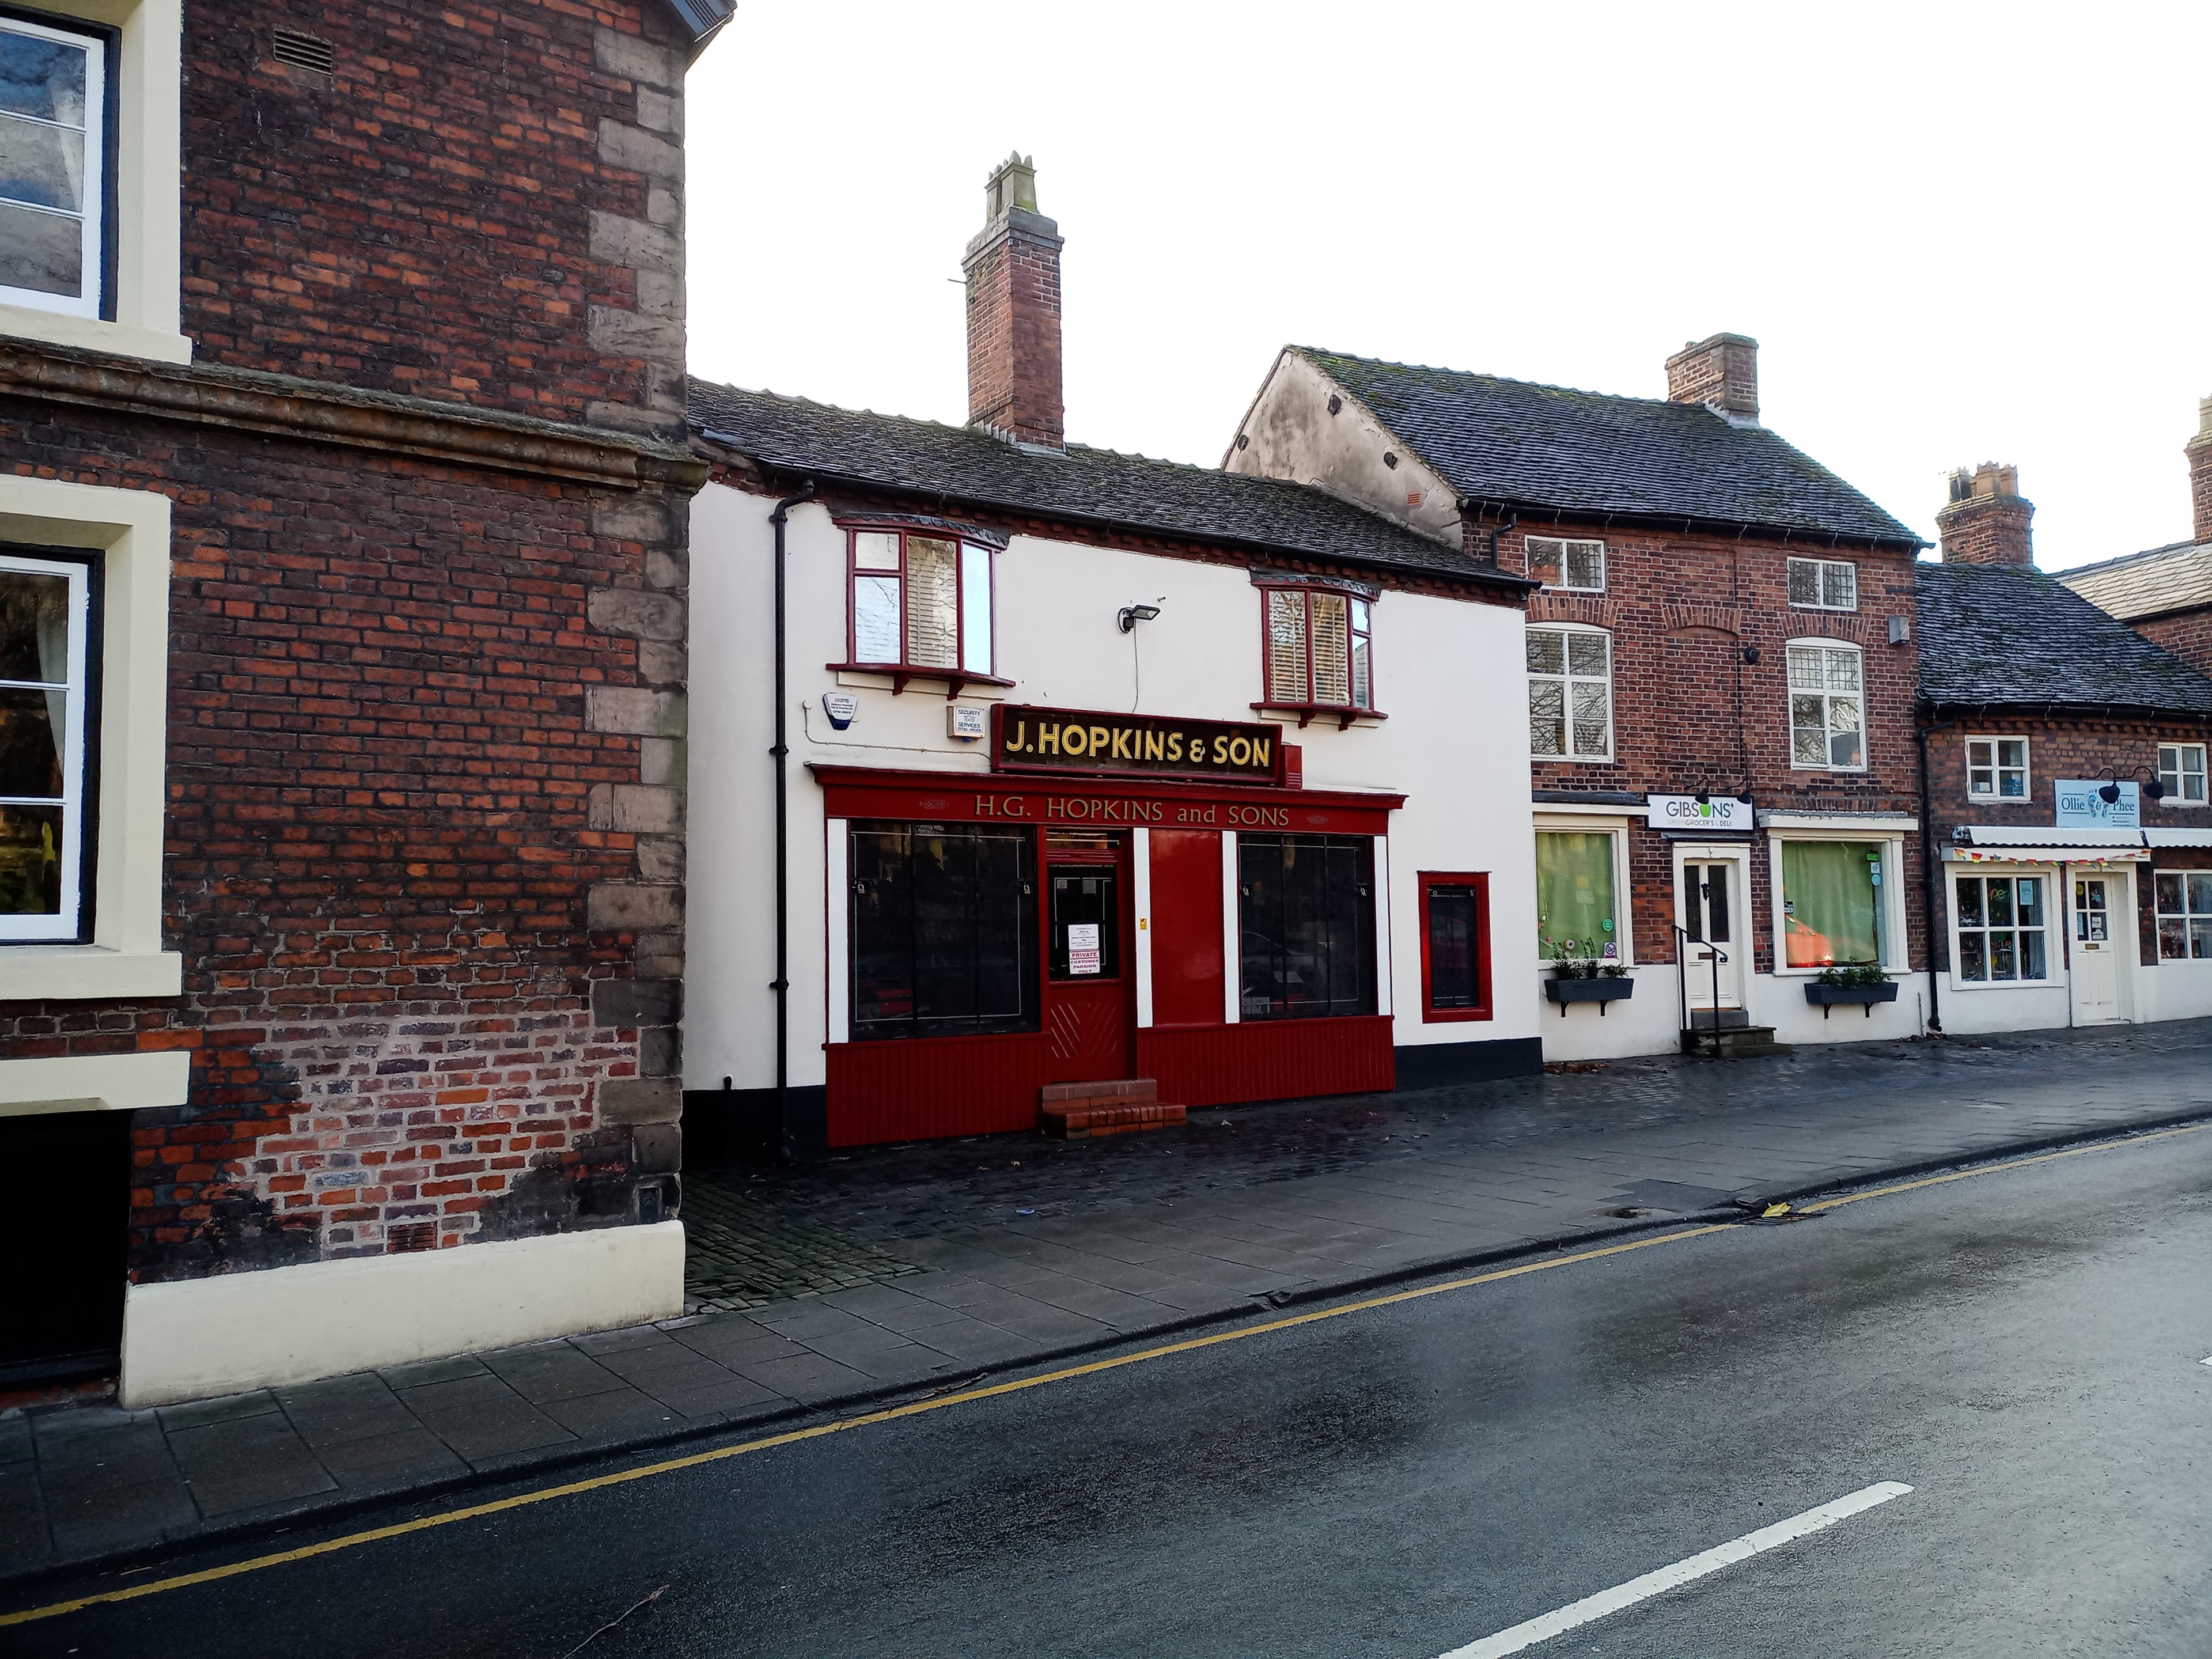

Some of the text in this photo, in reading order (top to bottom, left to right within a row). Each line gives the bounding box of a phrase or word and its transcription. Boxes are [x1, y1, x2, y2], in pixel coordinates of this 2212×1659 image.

[1190, 739, 1206, 762] &
[1212, 736, 1270, 767] SON
[975, 795, 1290, 827] H.G. HOPKINS and SONS
[2061, 797, 2135, 812] Ollie & Phee
